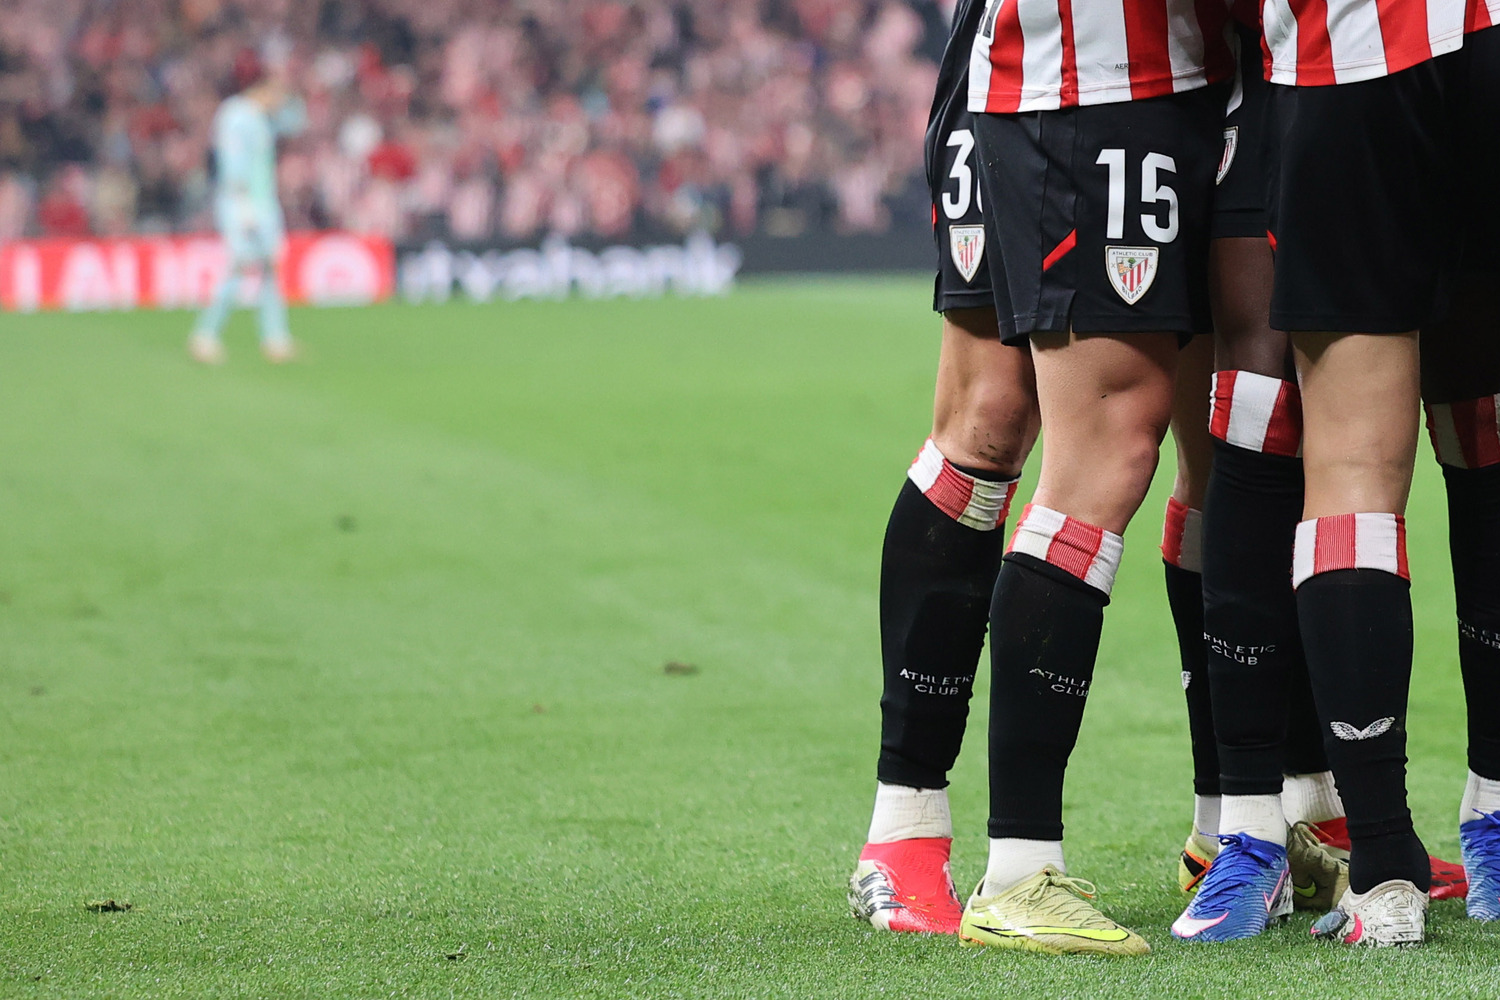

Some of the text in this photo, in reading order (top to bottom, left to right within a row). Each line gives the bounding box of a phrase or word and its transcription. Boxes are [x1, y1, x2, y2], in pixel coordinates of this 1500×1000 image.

[941, 128, 984, 220] 3
[1095, 148, 1180, 244] 15
[1211, 645, 1258, 666] CLUB
[914, 684, 960, 696] CLUB
